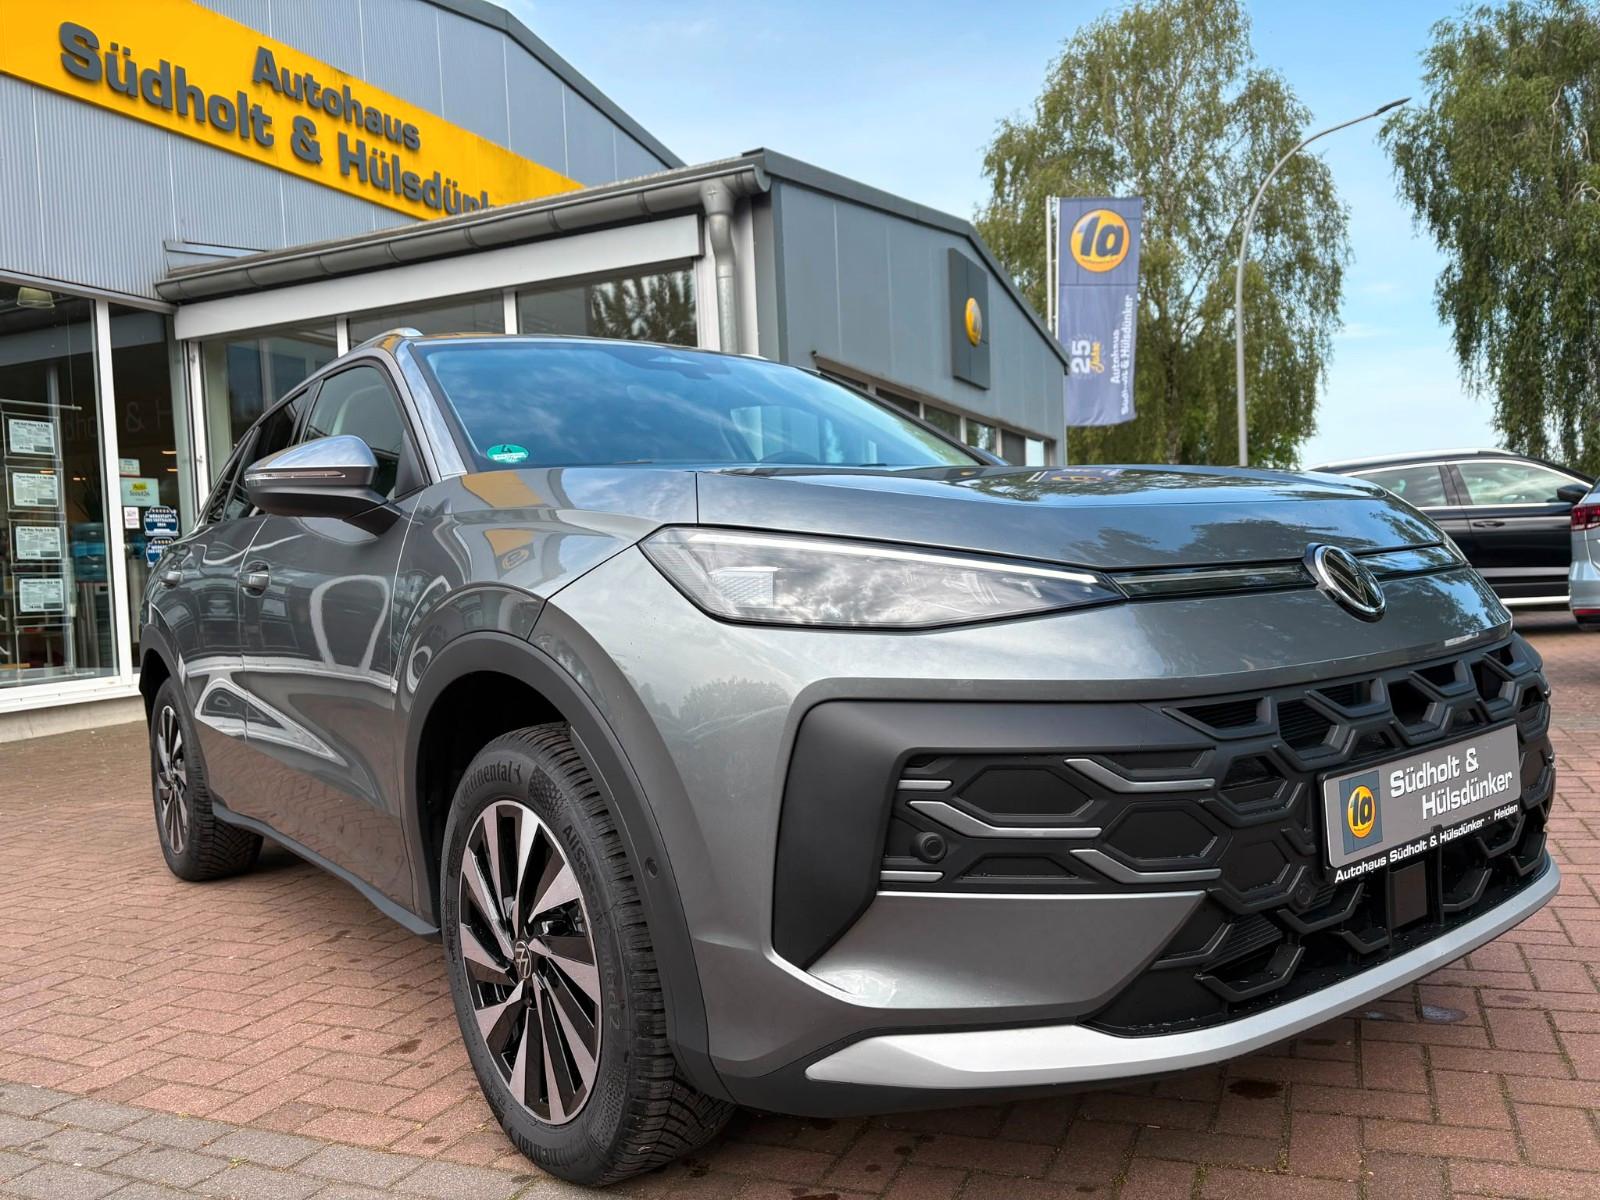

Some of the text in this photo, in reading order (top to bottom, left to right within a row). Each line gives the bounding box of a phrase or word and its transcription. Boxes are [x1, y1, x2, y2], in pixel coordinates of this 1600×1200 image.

[58, 21, 274, 147] Südholt
[289, 116, 323, 164] &
[252, 46, 421, 151] Autohaus
[1121, 295, 1133, 357] Hülsdünker
[1071, 340, 1090, 374] 25
[1110, 329, 1120, 384] Autohaus
[1390, 747, 1480, 798] Südholt &
[1422, 770, 1513, 820] Hülsdünker
[1335, 803, 1518, 884] Autohaus Südholt & Hülsdünker Heiden
